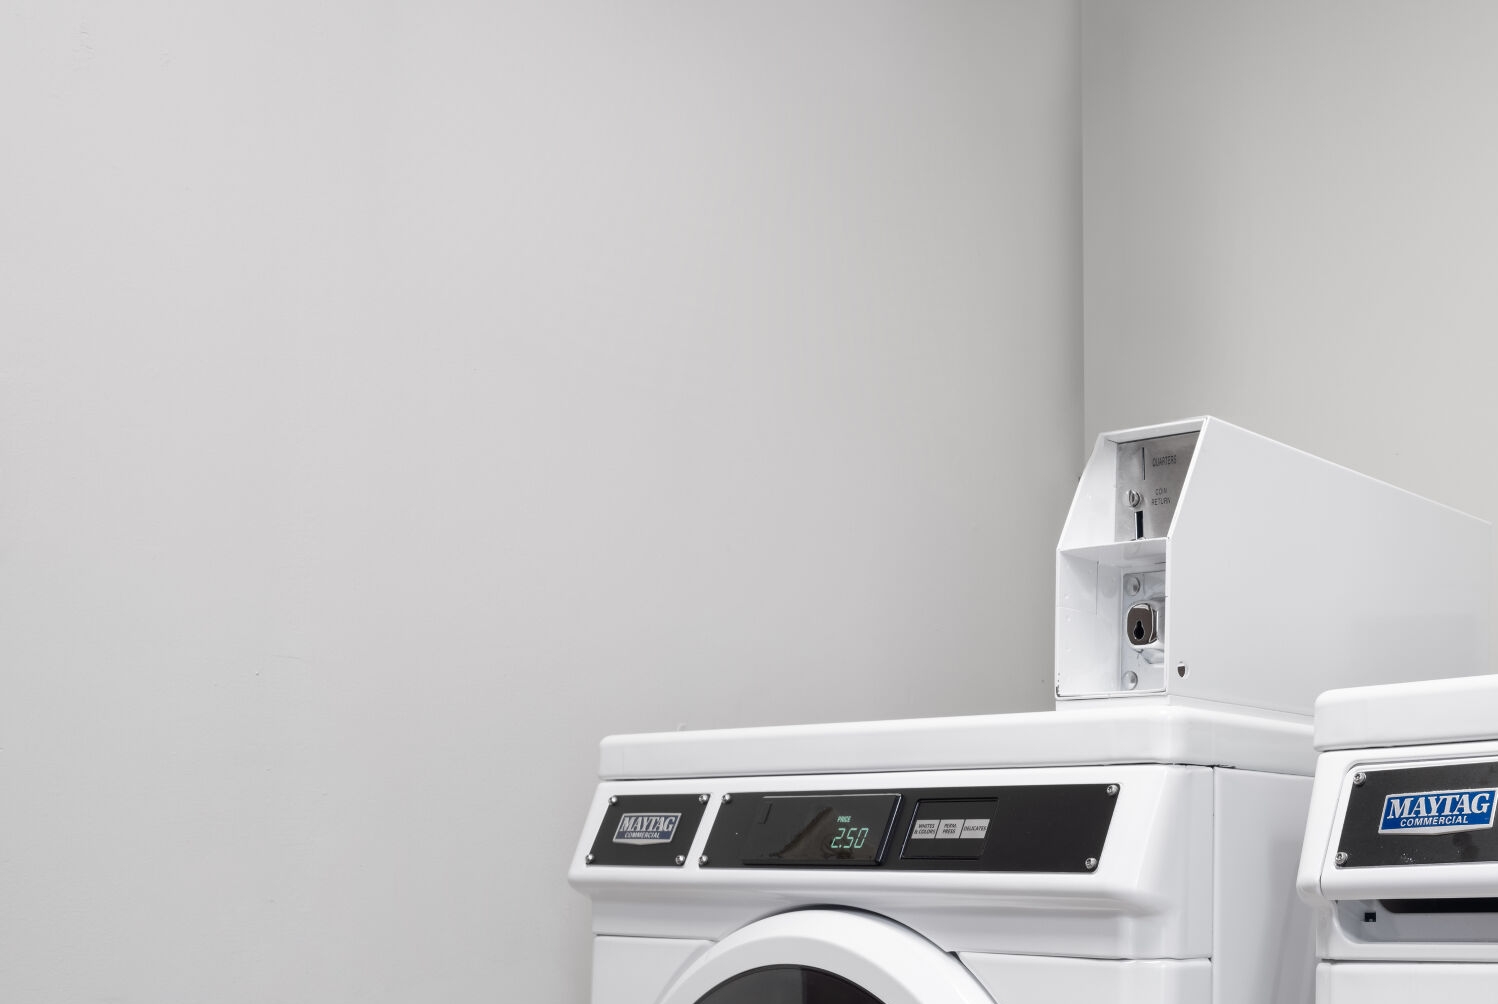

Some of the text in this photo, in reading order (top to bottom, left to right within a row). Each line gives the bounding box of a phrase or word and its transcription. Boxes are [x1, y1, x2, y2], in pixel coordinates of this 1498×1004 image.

[1387, 793, 1490, 820] MAYTAG
[619, 816, 676, 832] MAYTAG
[1400, 815, 1469, 827] COMMERCIAL
[624, 831, 660, 839] COMMERCIAL
[830, 827, 869, 849] 2.50
